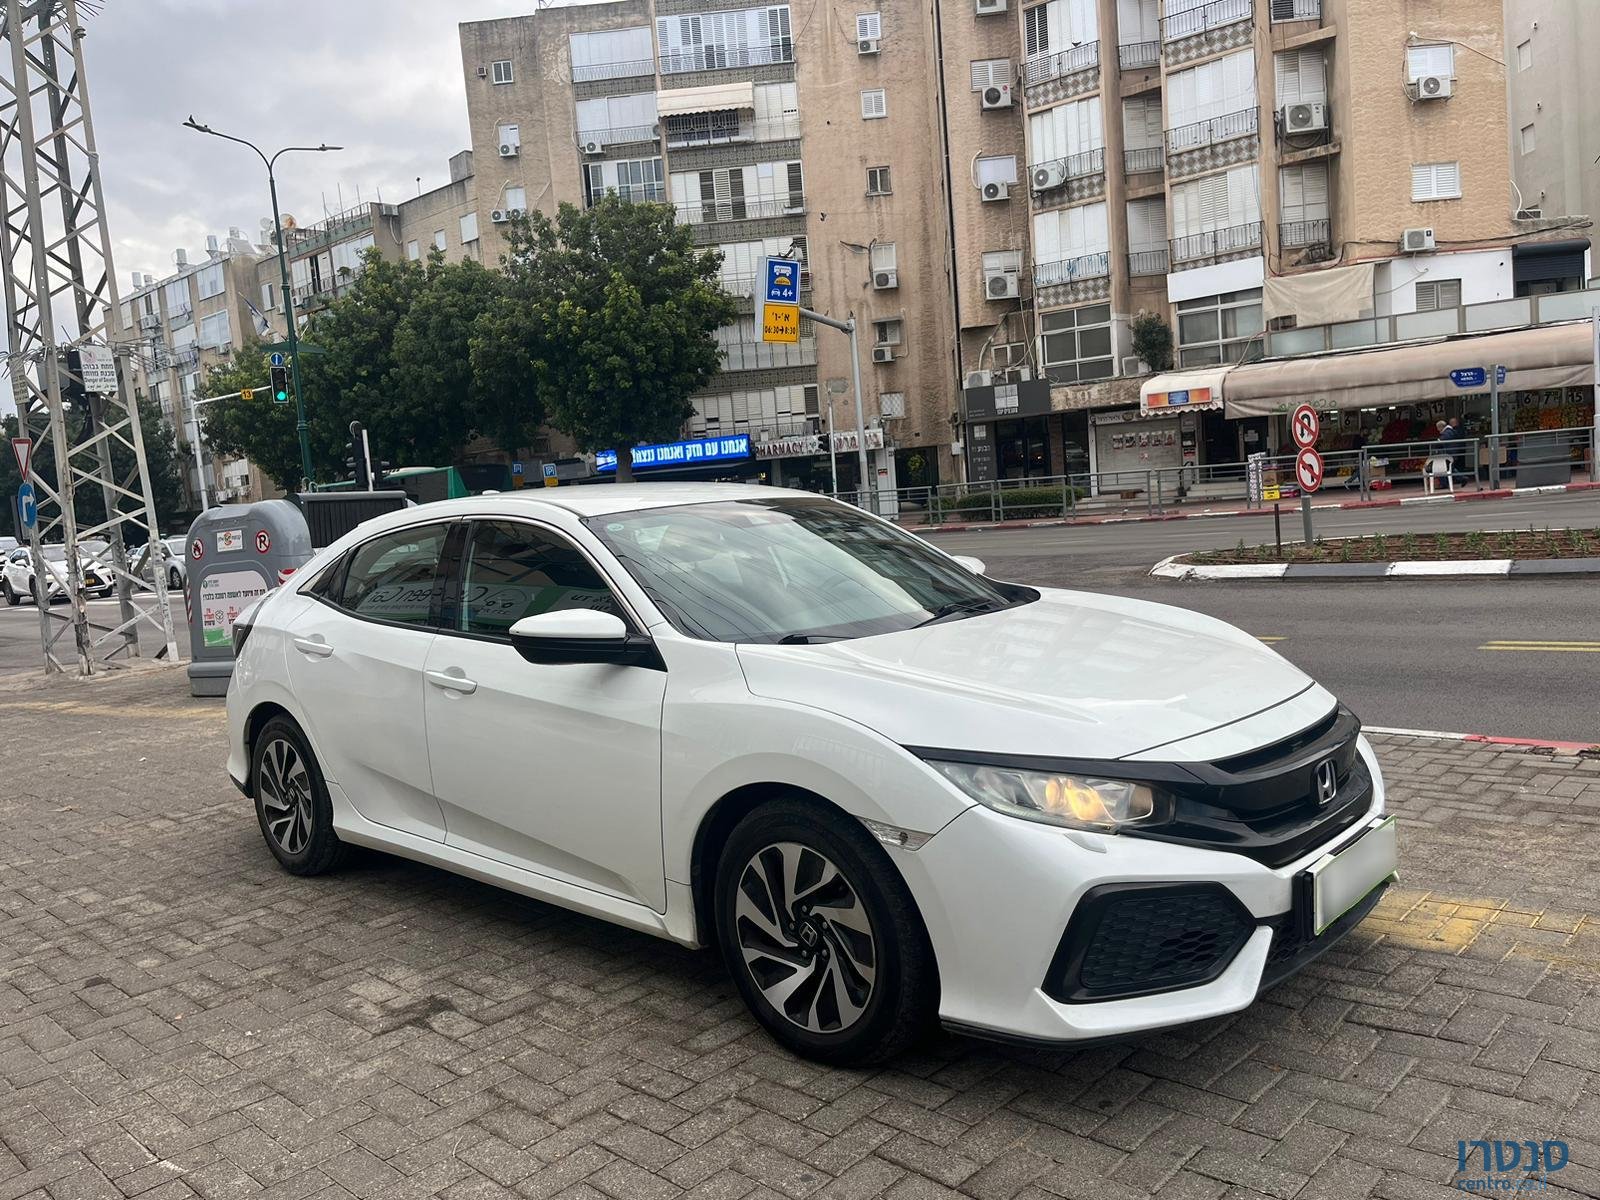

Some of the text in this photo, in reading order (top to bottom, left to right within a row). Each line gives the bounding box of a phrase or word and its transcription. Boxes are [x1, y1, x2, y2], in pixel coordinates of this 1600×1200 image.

[243, 390, 252, 398] 13
[657, 445, 684, 461] ואנחנו
[686, 444, 703, 461] חזק
[705, 443, 719, 456] עם
[721, 438, 747, 455] אנחנו
[755, 441, 804, 457] PHARMACY
